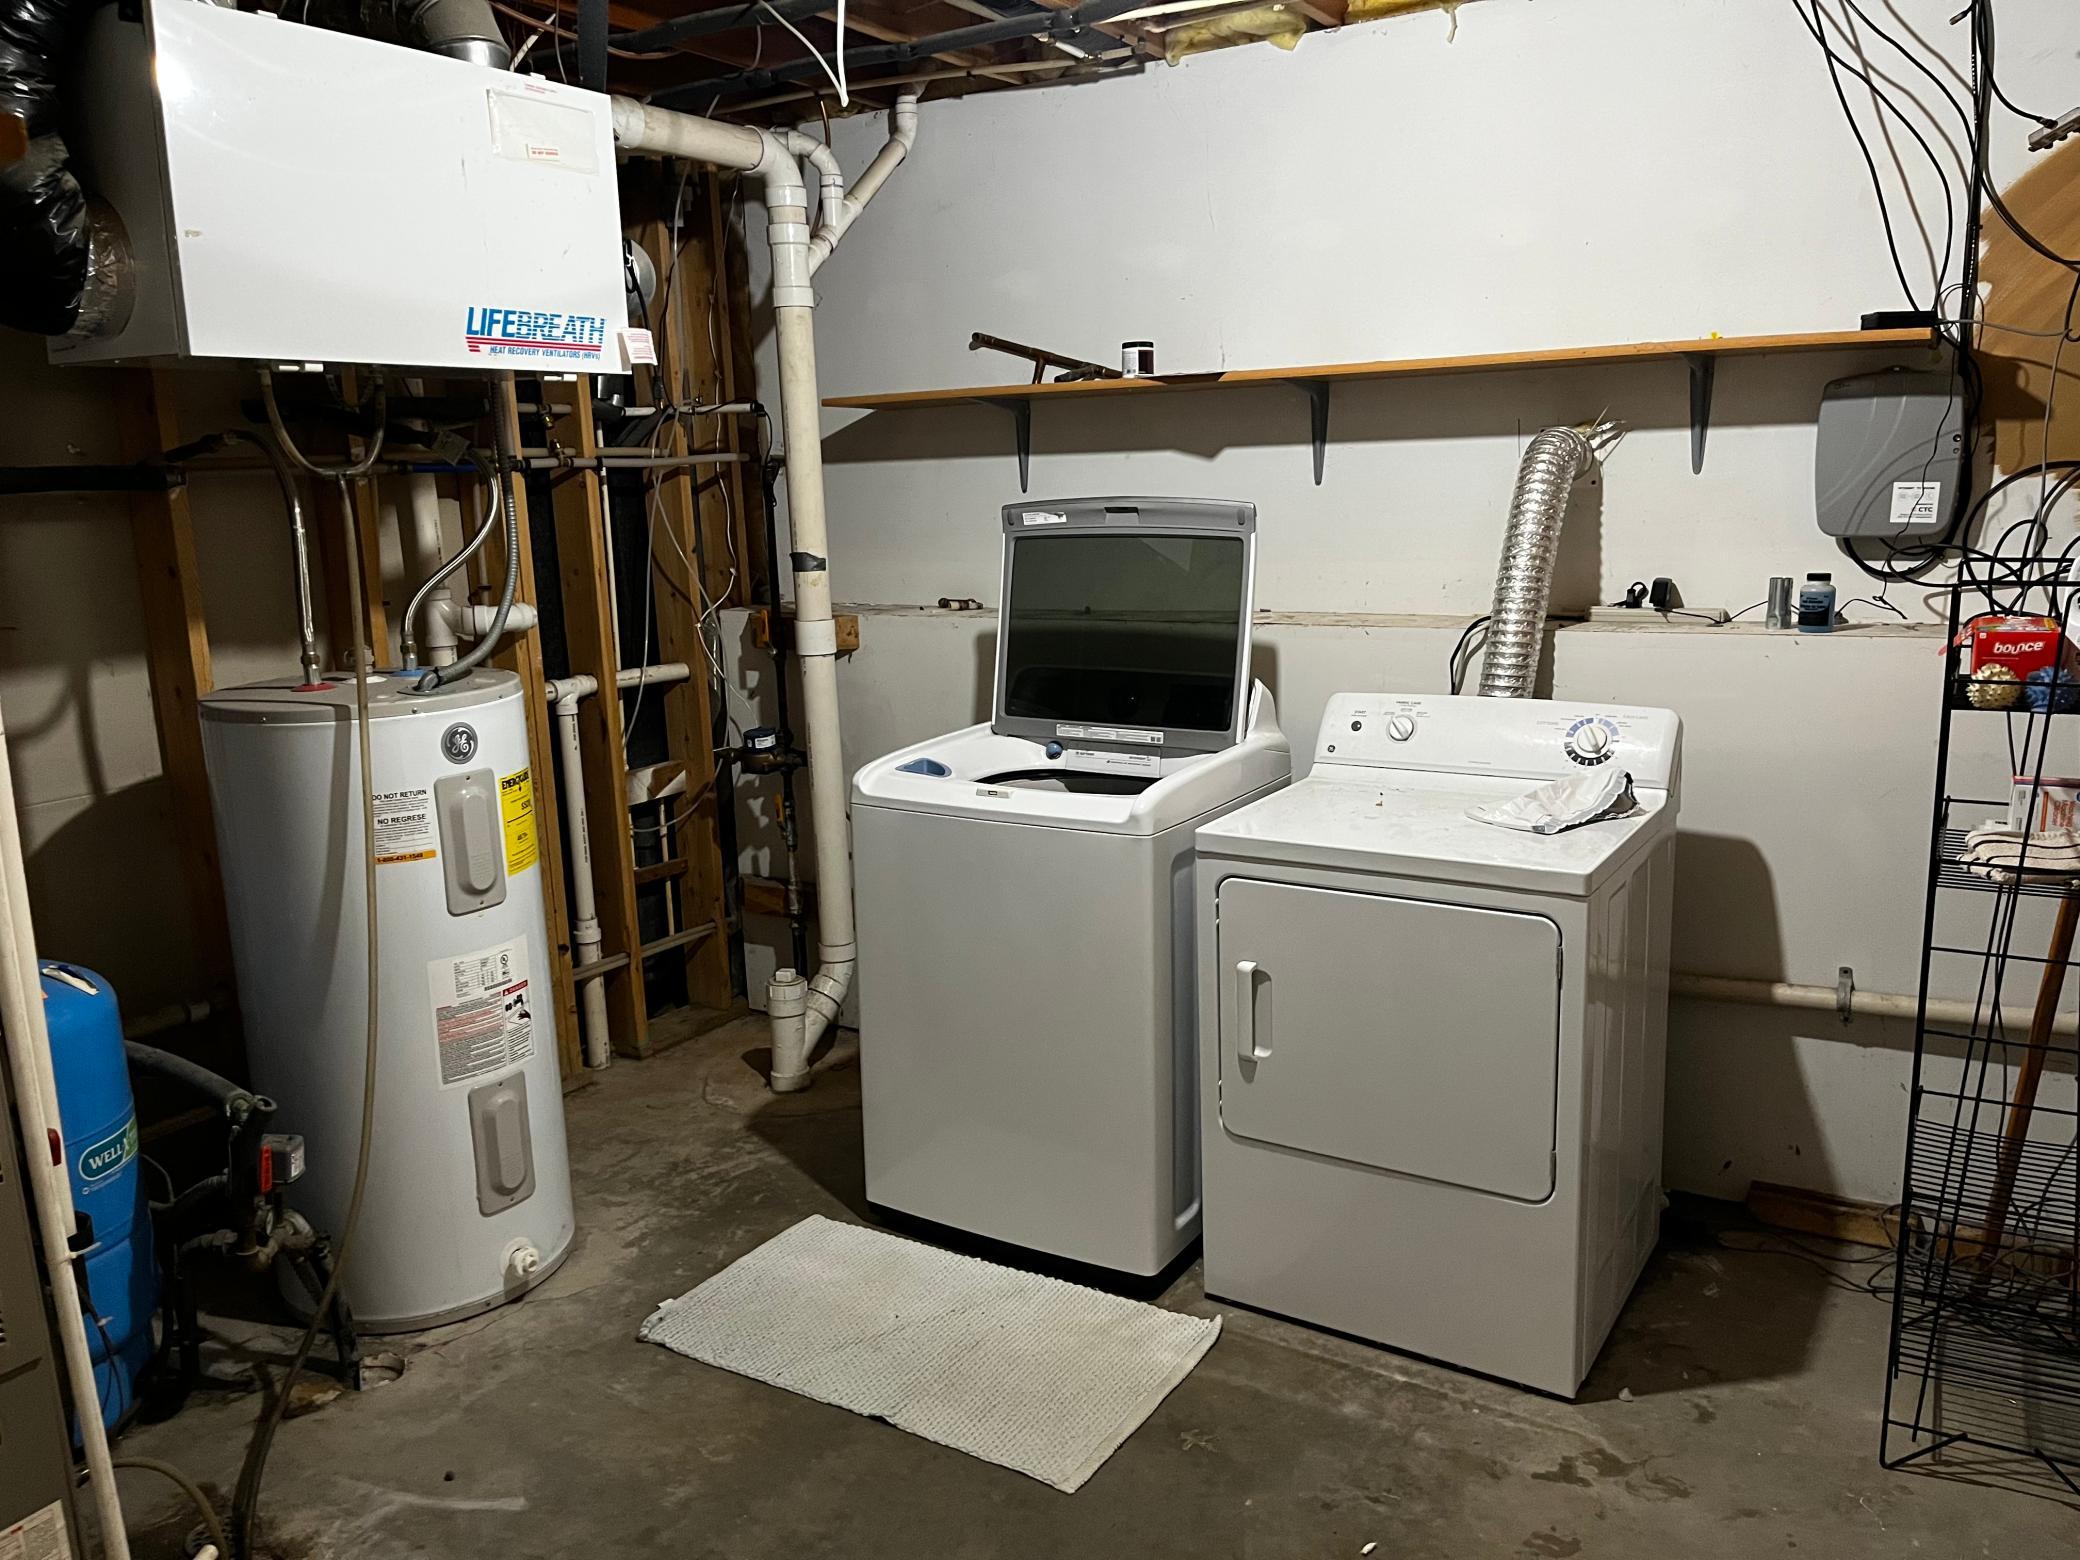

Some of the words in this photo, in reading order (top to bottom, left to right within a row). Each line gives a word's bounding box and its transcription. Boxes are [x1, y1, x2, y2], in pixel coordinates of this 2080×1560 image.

[465, 306, 607, 344] LIFEBREATH
[490, 345, 506, 354] HEAT
[507, 347, 540, 356] RECOVERY
[541, 349, 581, 359] VENTILATORS
[1992, 641, 2047, 655] bounce
[383, 792, 399, 800] NOT
[399, 789, 427, 798] RETURN
[390, 813, 427, 824] REGRESE
